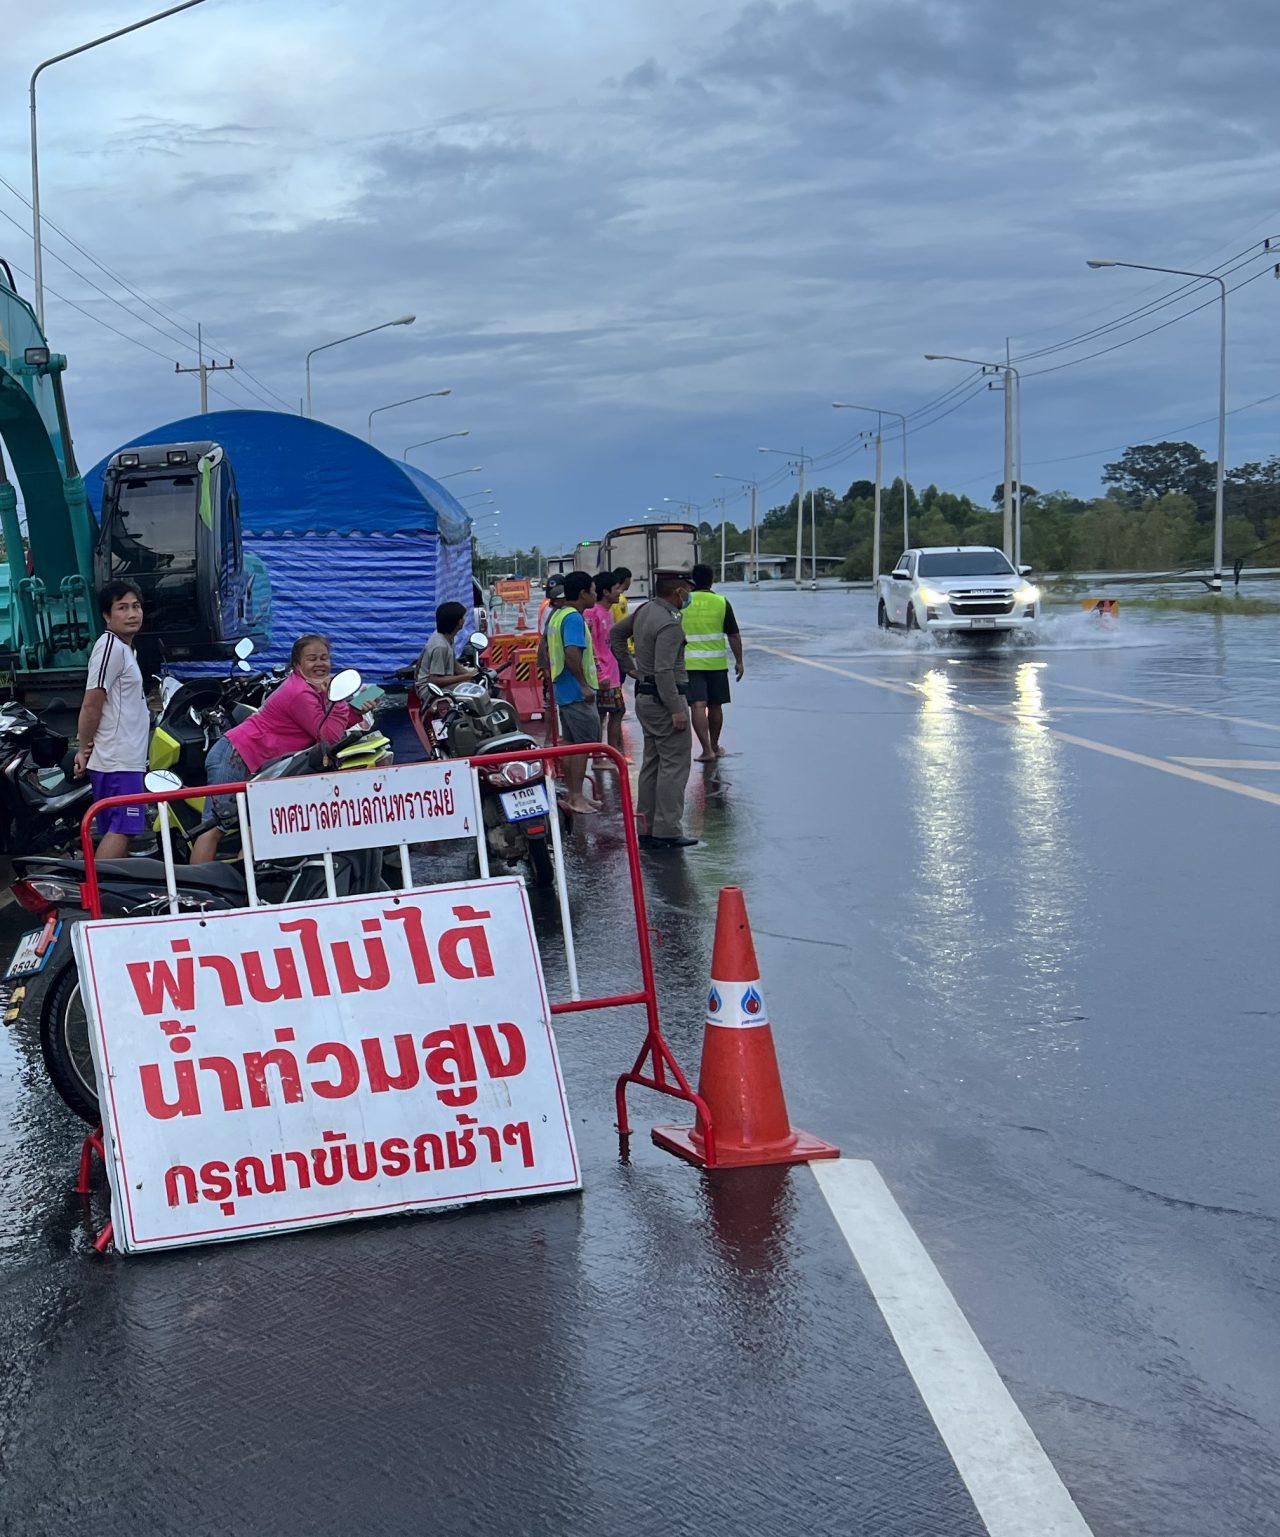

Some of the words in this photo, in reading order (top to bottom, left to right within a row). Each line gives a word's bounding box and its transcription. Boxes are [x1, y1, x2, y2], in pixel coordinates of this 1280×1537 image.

[270, 770, 455, 835] เทศบาลตำบลกันทรารมย์
[463, 816, 470, 833] 4
[513, 804, 544, 818] 3365
[126, 905, 495, 1016] ผ่านไม่ได้
[139, 1020, 527, 1119] น้ำท่วมสูง
[164, 1113, 536, 1216] กรุณาขับรถช้าๆ
